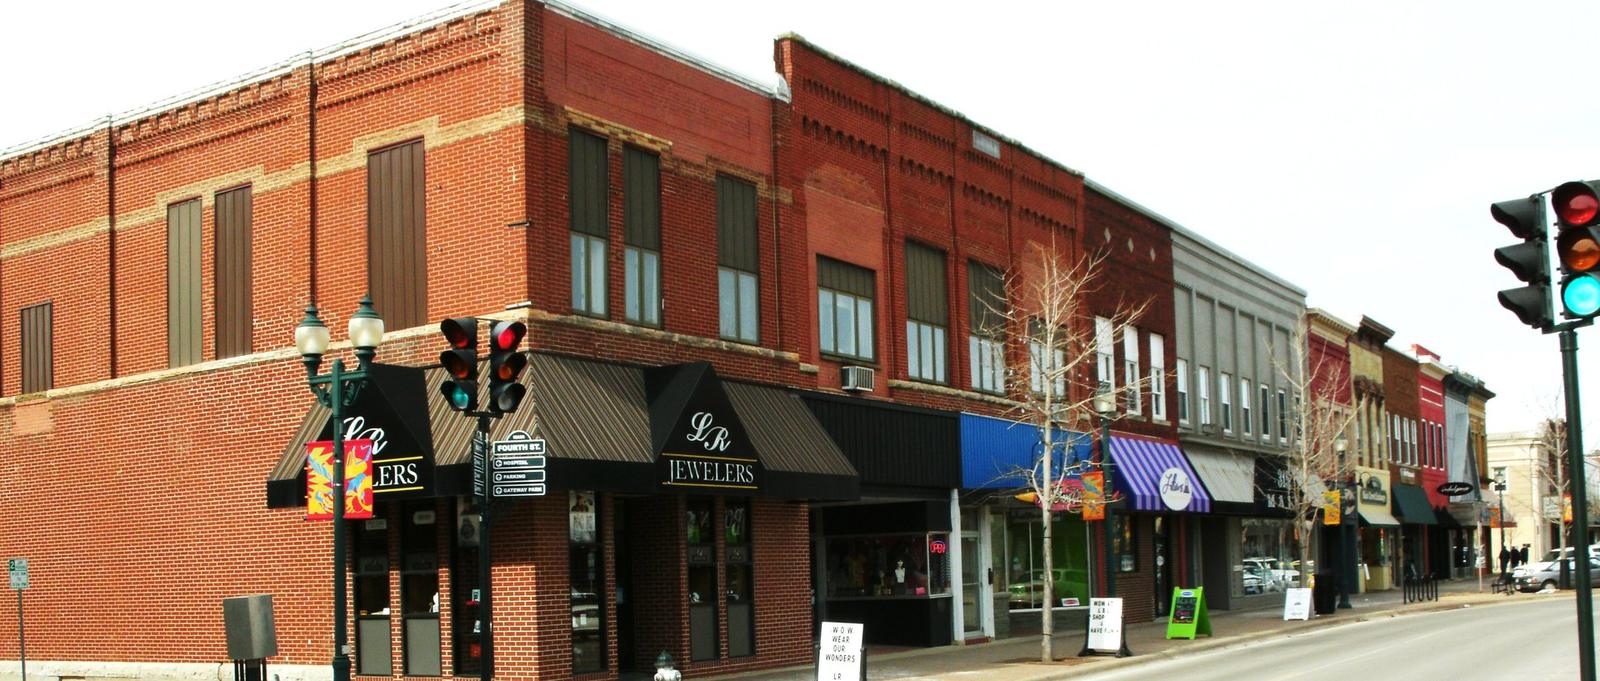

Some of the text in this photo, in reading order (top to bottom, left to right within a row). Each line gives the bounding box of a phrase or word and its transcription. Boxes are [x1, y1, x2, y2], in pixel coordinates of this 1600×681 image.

[686, 411, 732, 452] LR
[497, 443, 541, 452] FOURTH ST.
[668, 459, 754, 485] JEWELERS
[833, 645, 846, 653] OUR
[826, 654, 855, 663] WONDERS
[833, 672, 842, 680] LR
